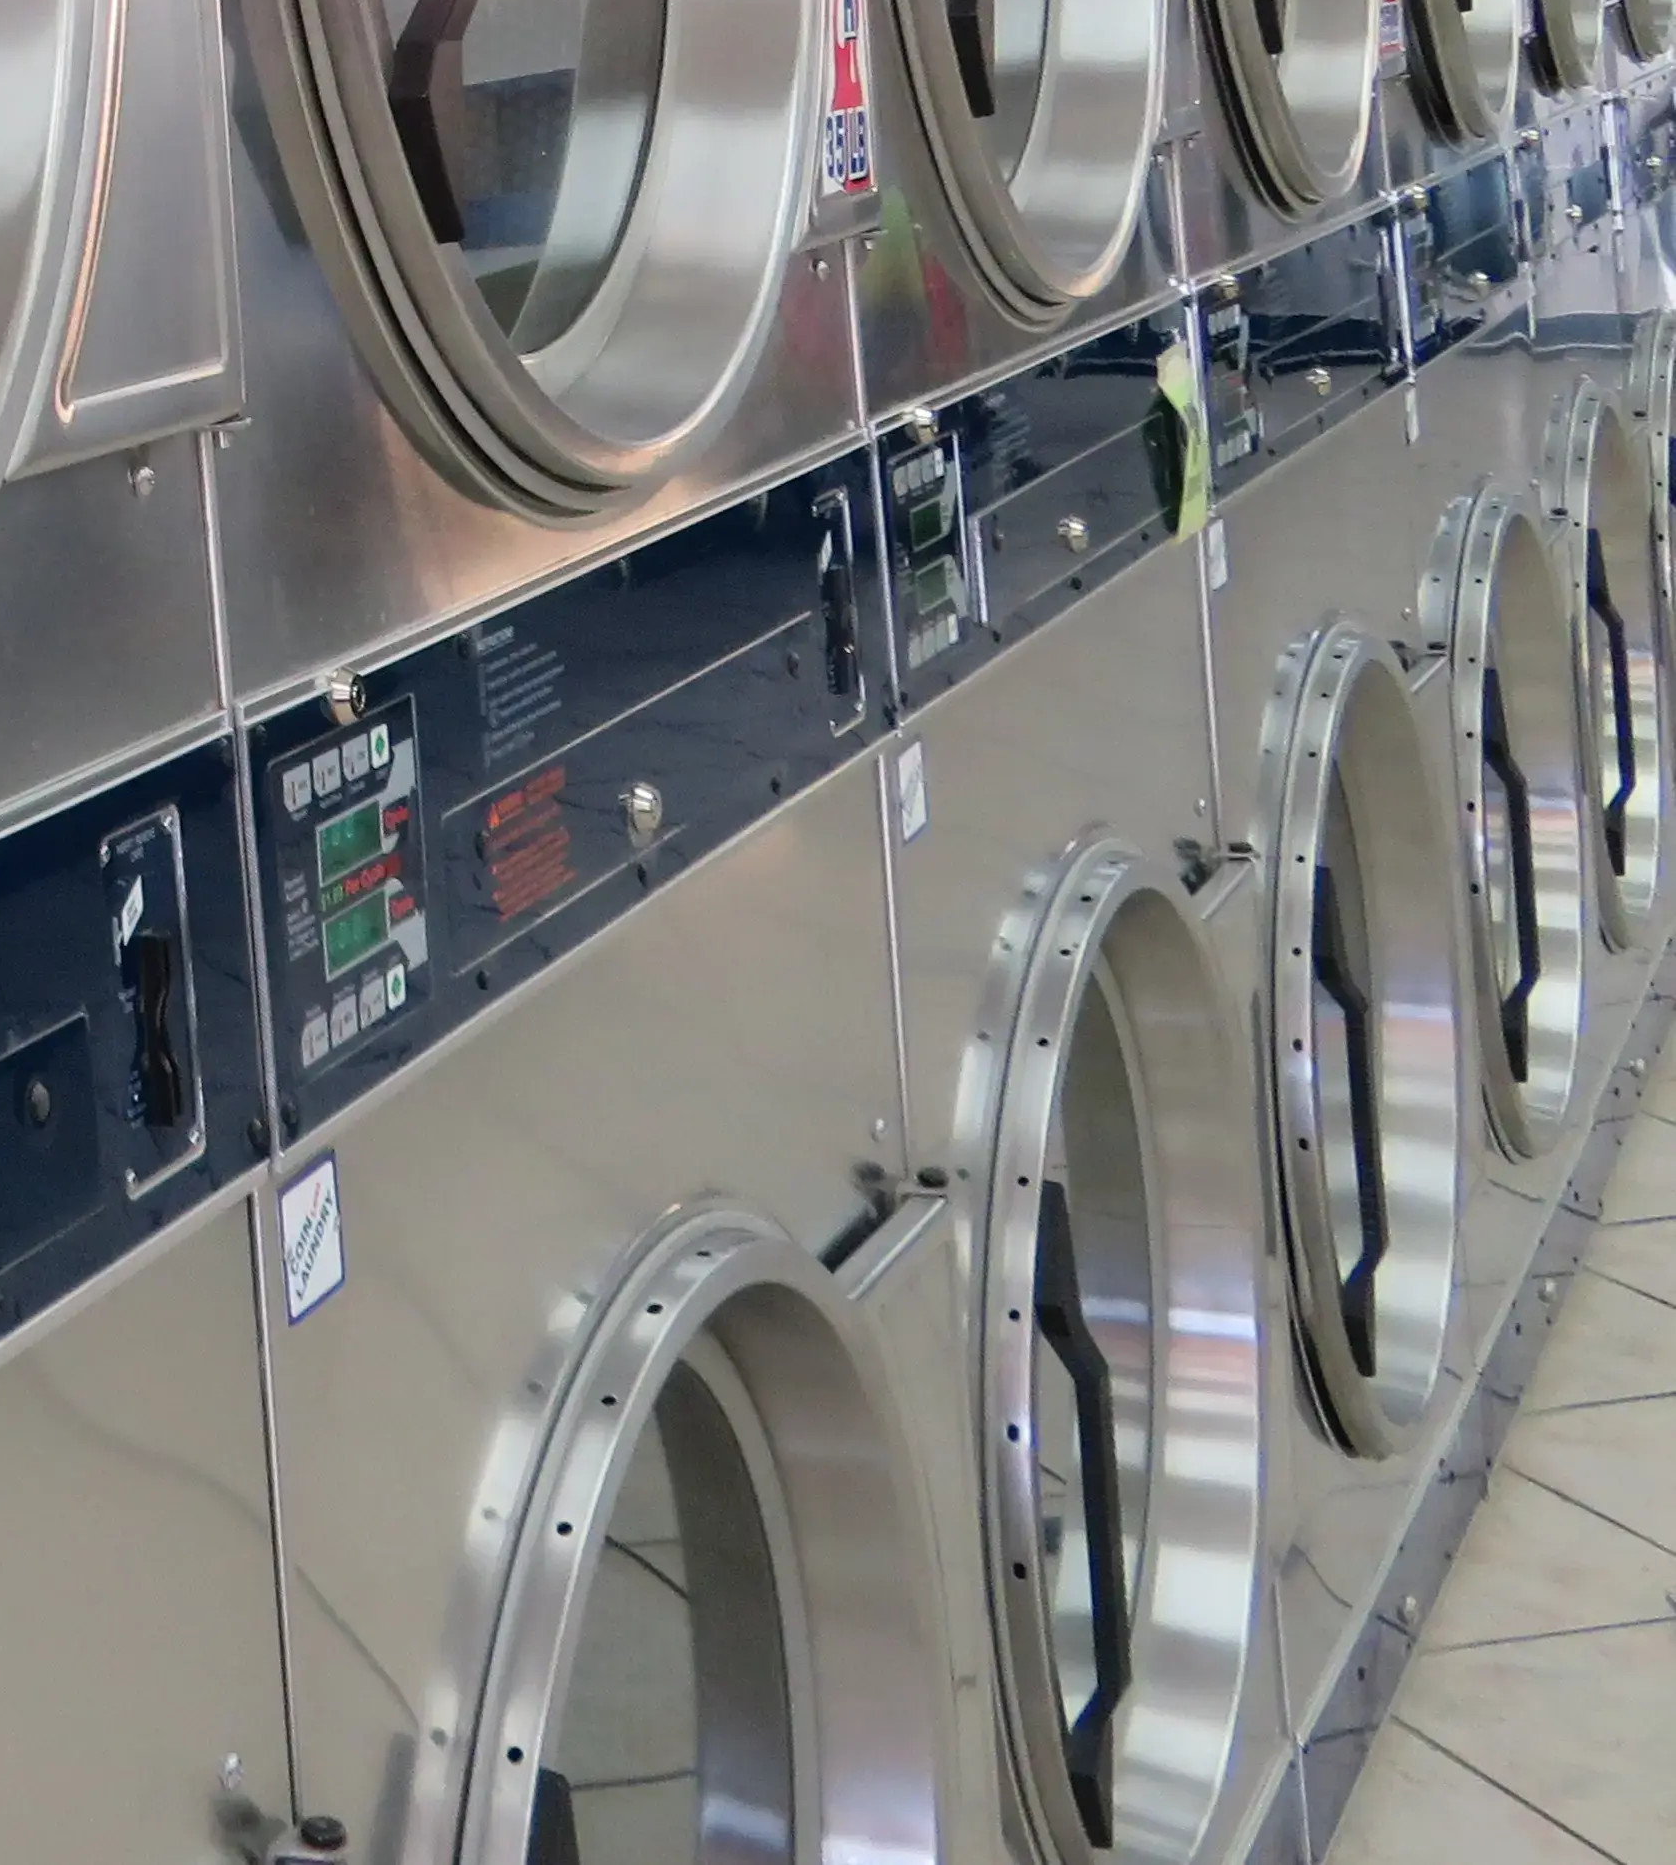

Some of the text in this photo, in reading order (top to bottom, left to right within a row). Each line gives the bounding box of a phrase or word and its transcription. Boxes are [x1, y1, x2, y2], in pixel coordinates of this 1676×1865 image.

[824, 110, 845, 182] 35
[289, 1214, 313, 1276] COIN
[295, 1188, 334, 1302] LAUNDRY
